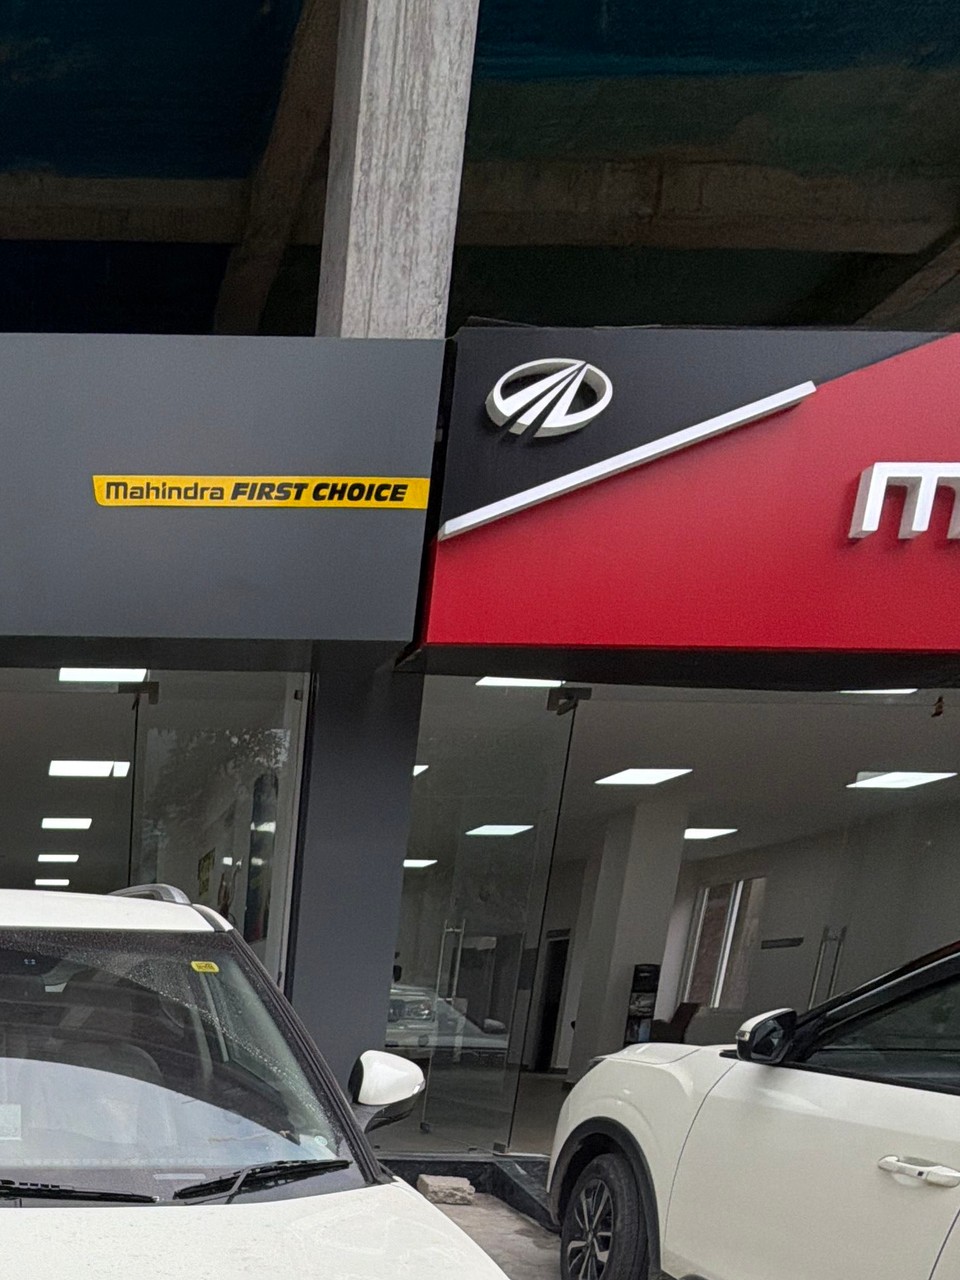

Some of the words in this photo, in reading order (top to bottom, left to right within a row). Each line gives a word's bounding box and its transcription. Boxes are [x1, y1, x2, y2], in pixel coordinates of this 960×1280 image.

[105, 481, 224, 500] Mahindra
[230, 482, 309, 501] FIRST
[312, 483, 408, 502] CHOICE
